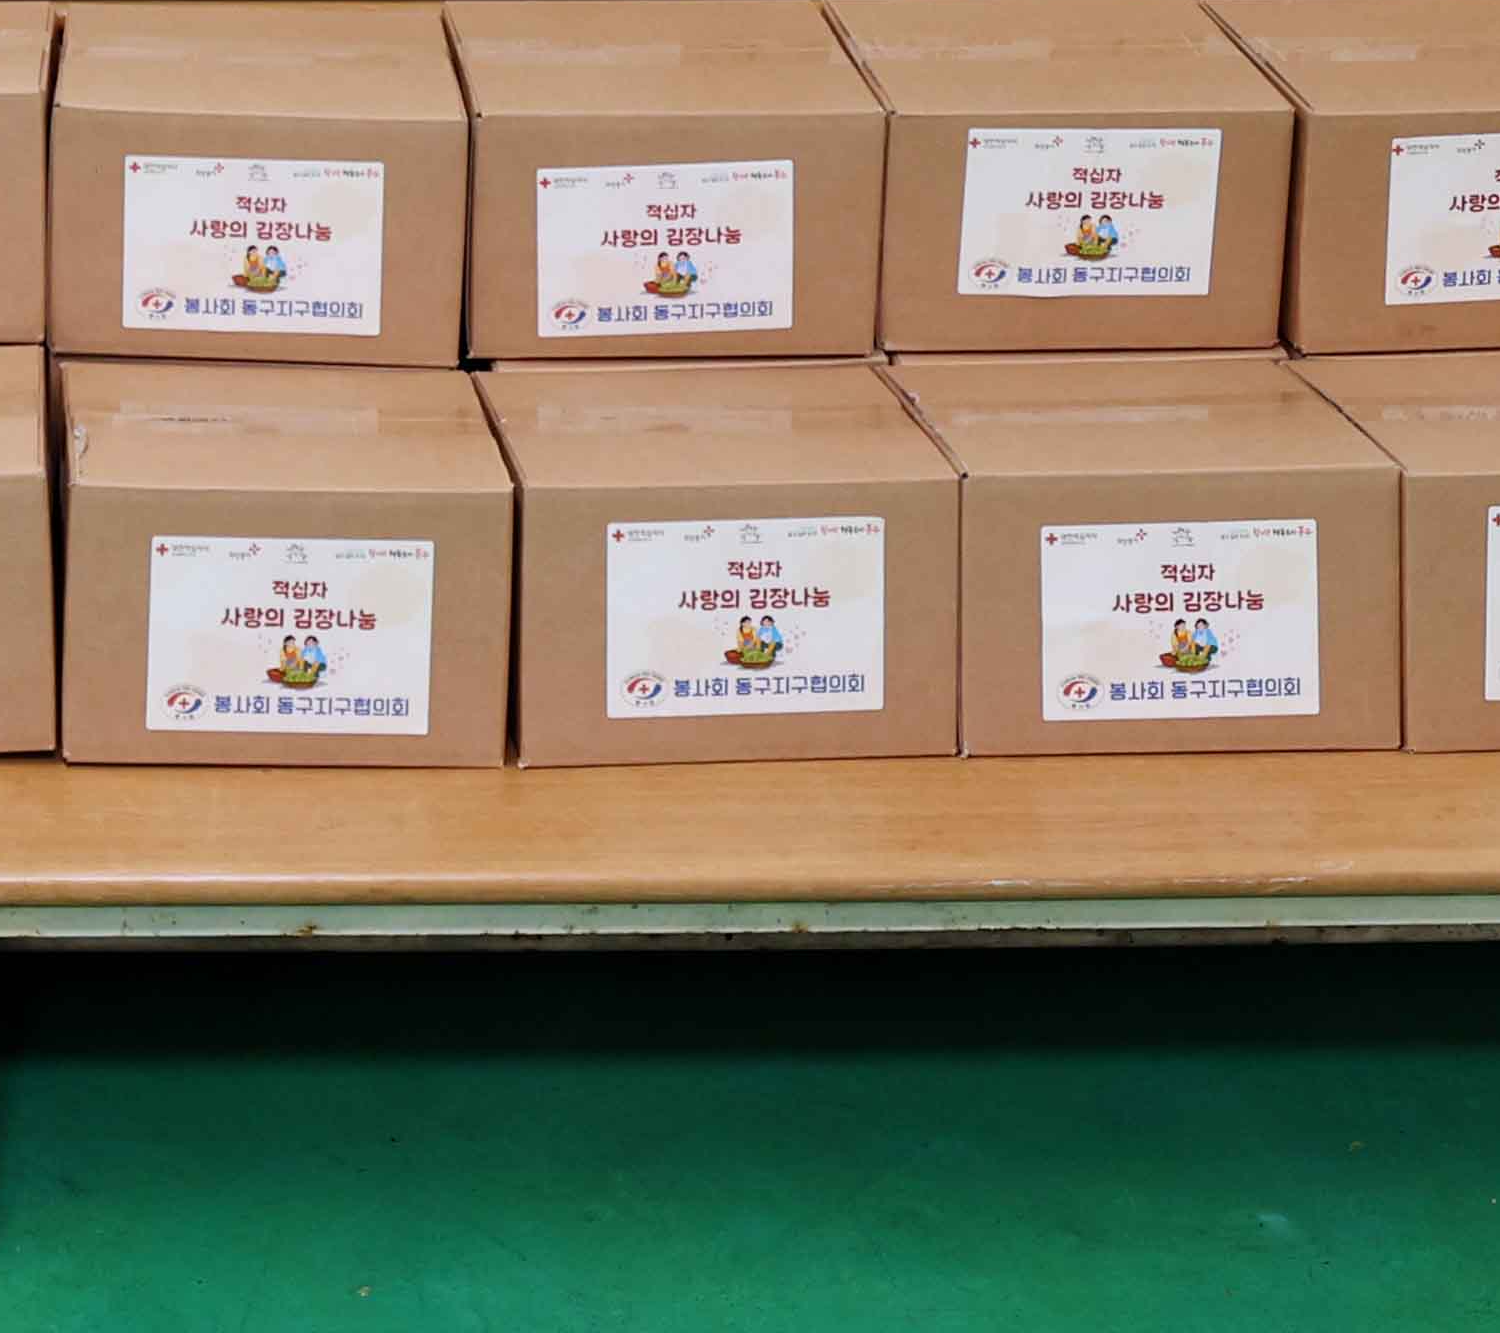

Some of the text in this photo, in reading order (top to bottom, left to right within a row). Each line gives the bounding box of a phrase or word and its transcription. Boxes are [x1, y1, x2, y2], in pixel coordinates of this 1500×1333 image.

[1071, 167, 1125, 185] 적십자
[235, 195, 289, 215] 적십자
[1025, 191, 1167, 211] 사랑의 김장나눔
[189, 218, 333, 243] 사랑의 김장나눔
[726, 558, 783, 580] 적십자
[1160, 562, 1217, 584] 적십자
[270, 579, 329, 601] 적십자
[677, 585, 833, 612] 사랑의 김장나눔
[1111, 588, 1266, 615] 사랑의 김장나눔
[219, 606, 379, 632] 사랑의 김장나눔
[673, 671, 869, 700] 봉사회 동구지구협의회
[1108, 676, 1303, 703] 봉사회 동구지구협의회
[213, 694, 413, 719] 봉사회 동구지구협의회
